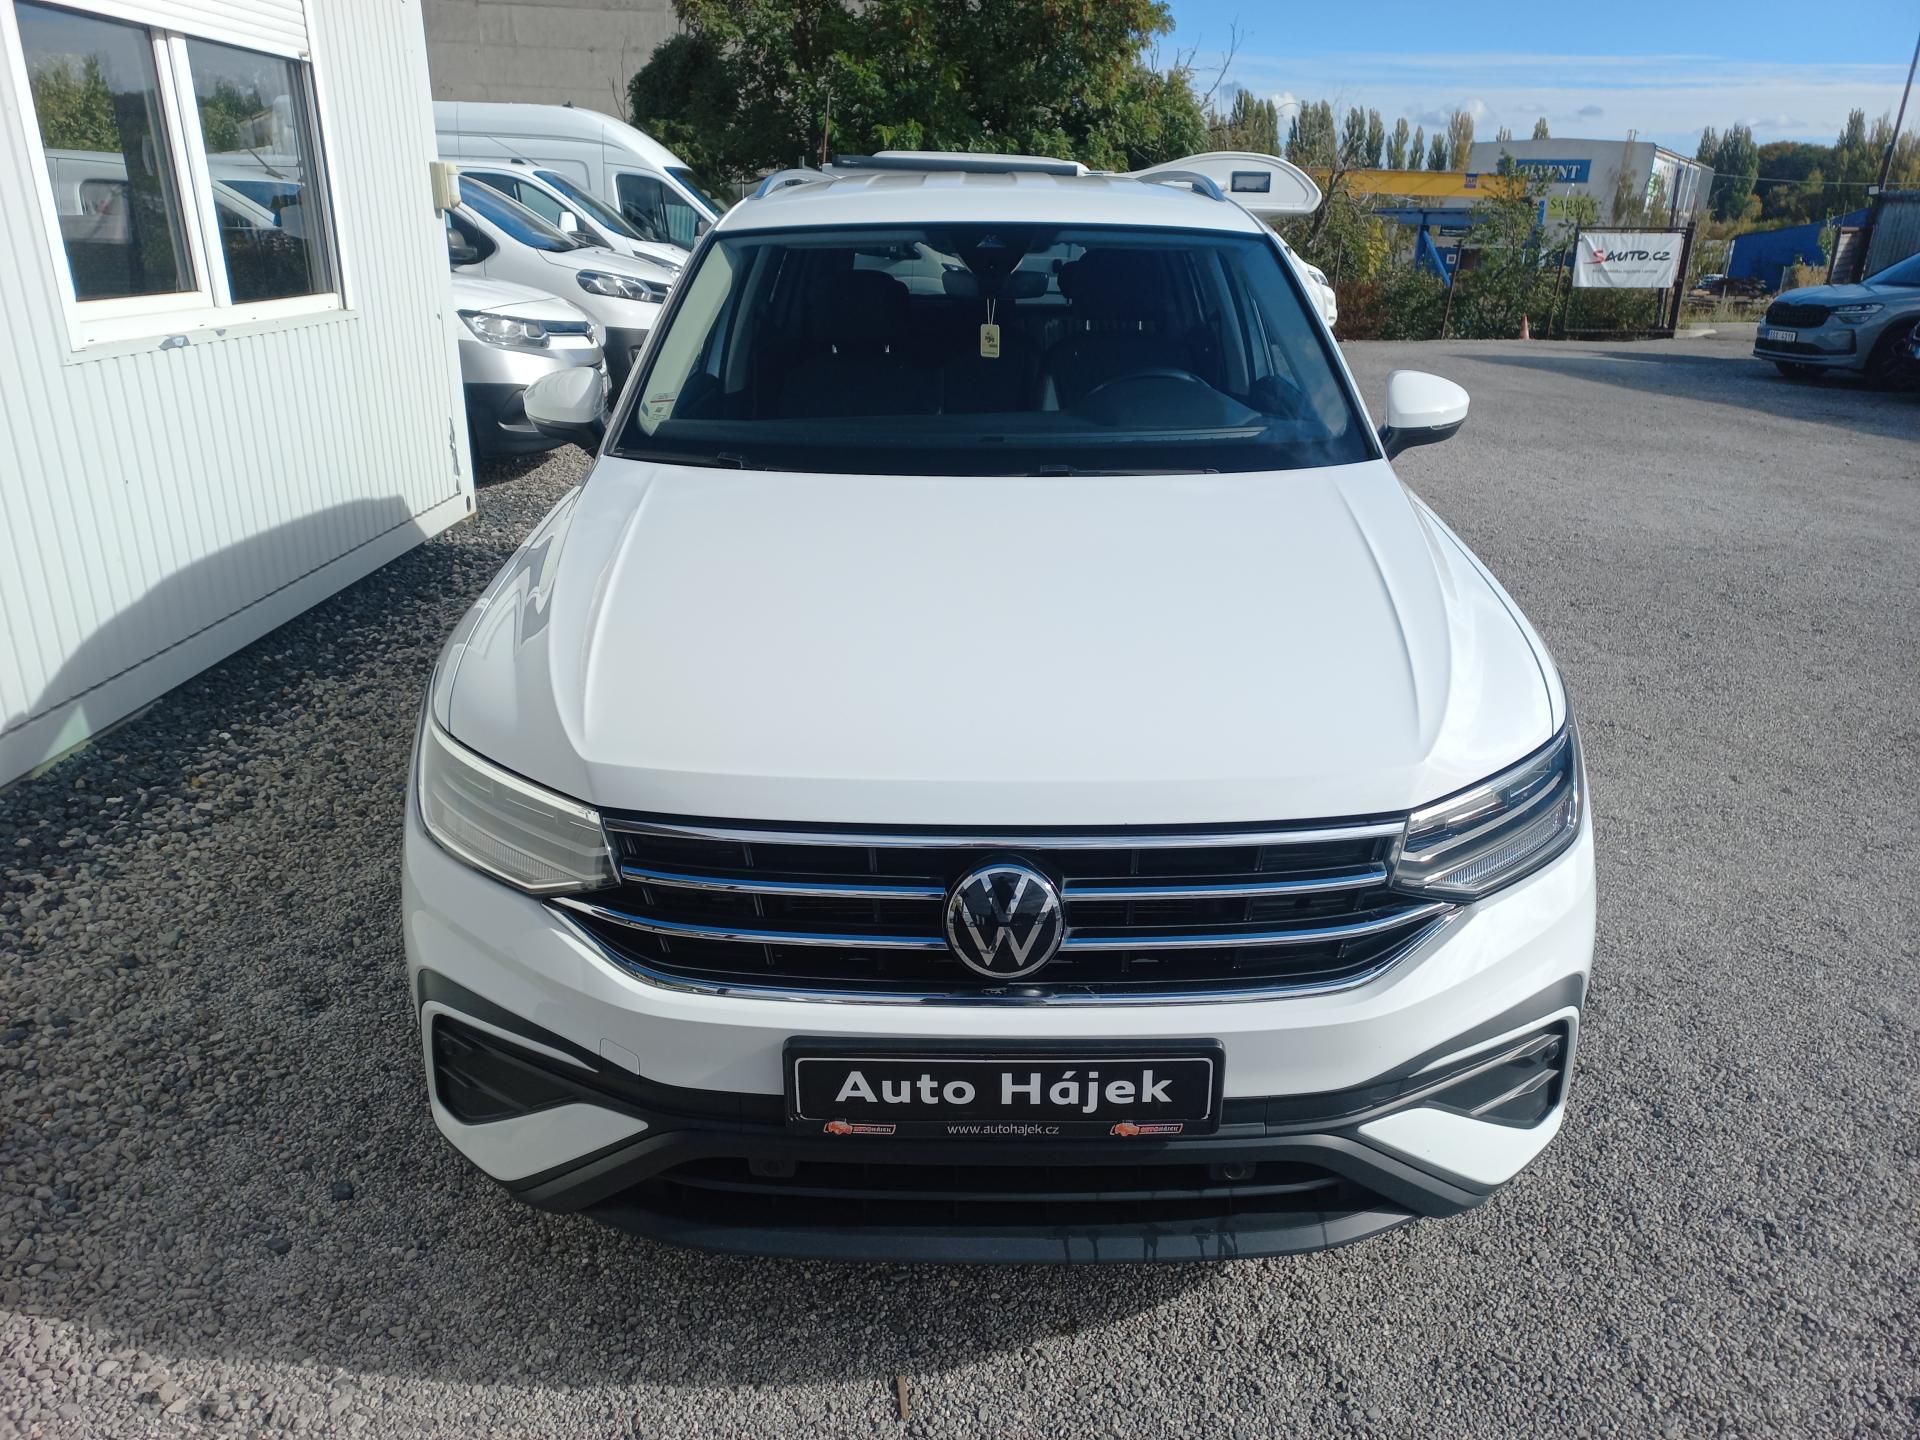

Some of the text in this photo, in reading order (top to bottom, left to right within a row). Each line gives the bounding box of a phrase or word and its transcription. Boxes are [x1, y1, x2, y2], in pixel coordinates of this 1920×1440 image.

[835, 1069, 1173, 1114] Auto Hájek
[947, 1123, 1060, 1137] www.autohajek.cz
